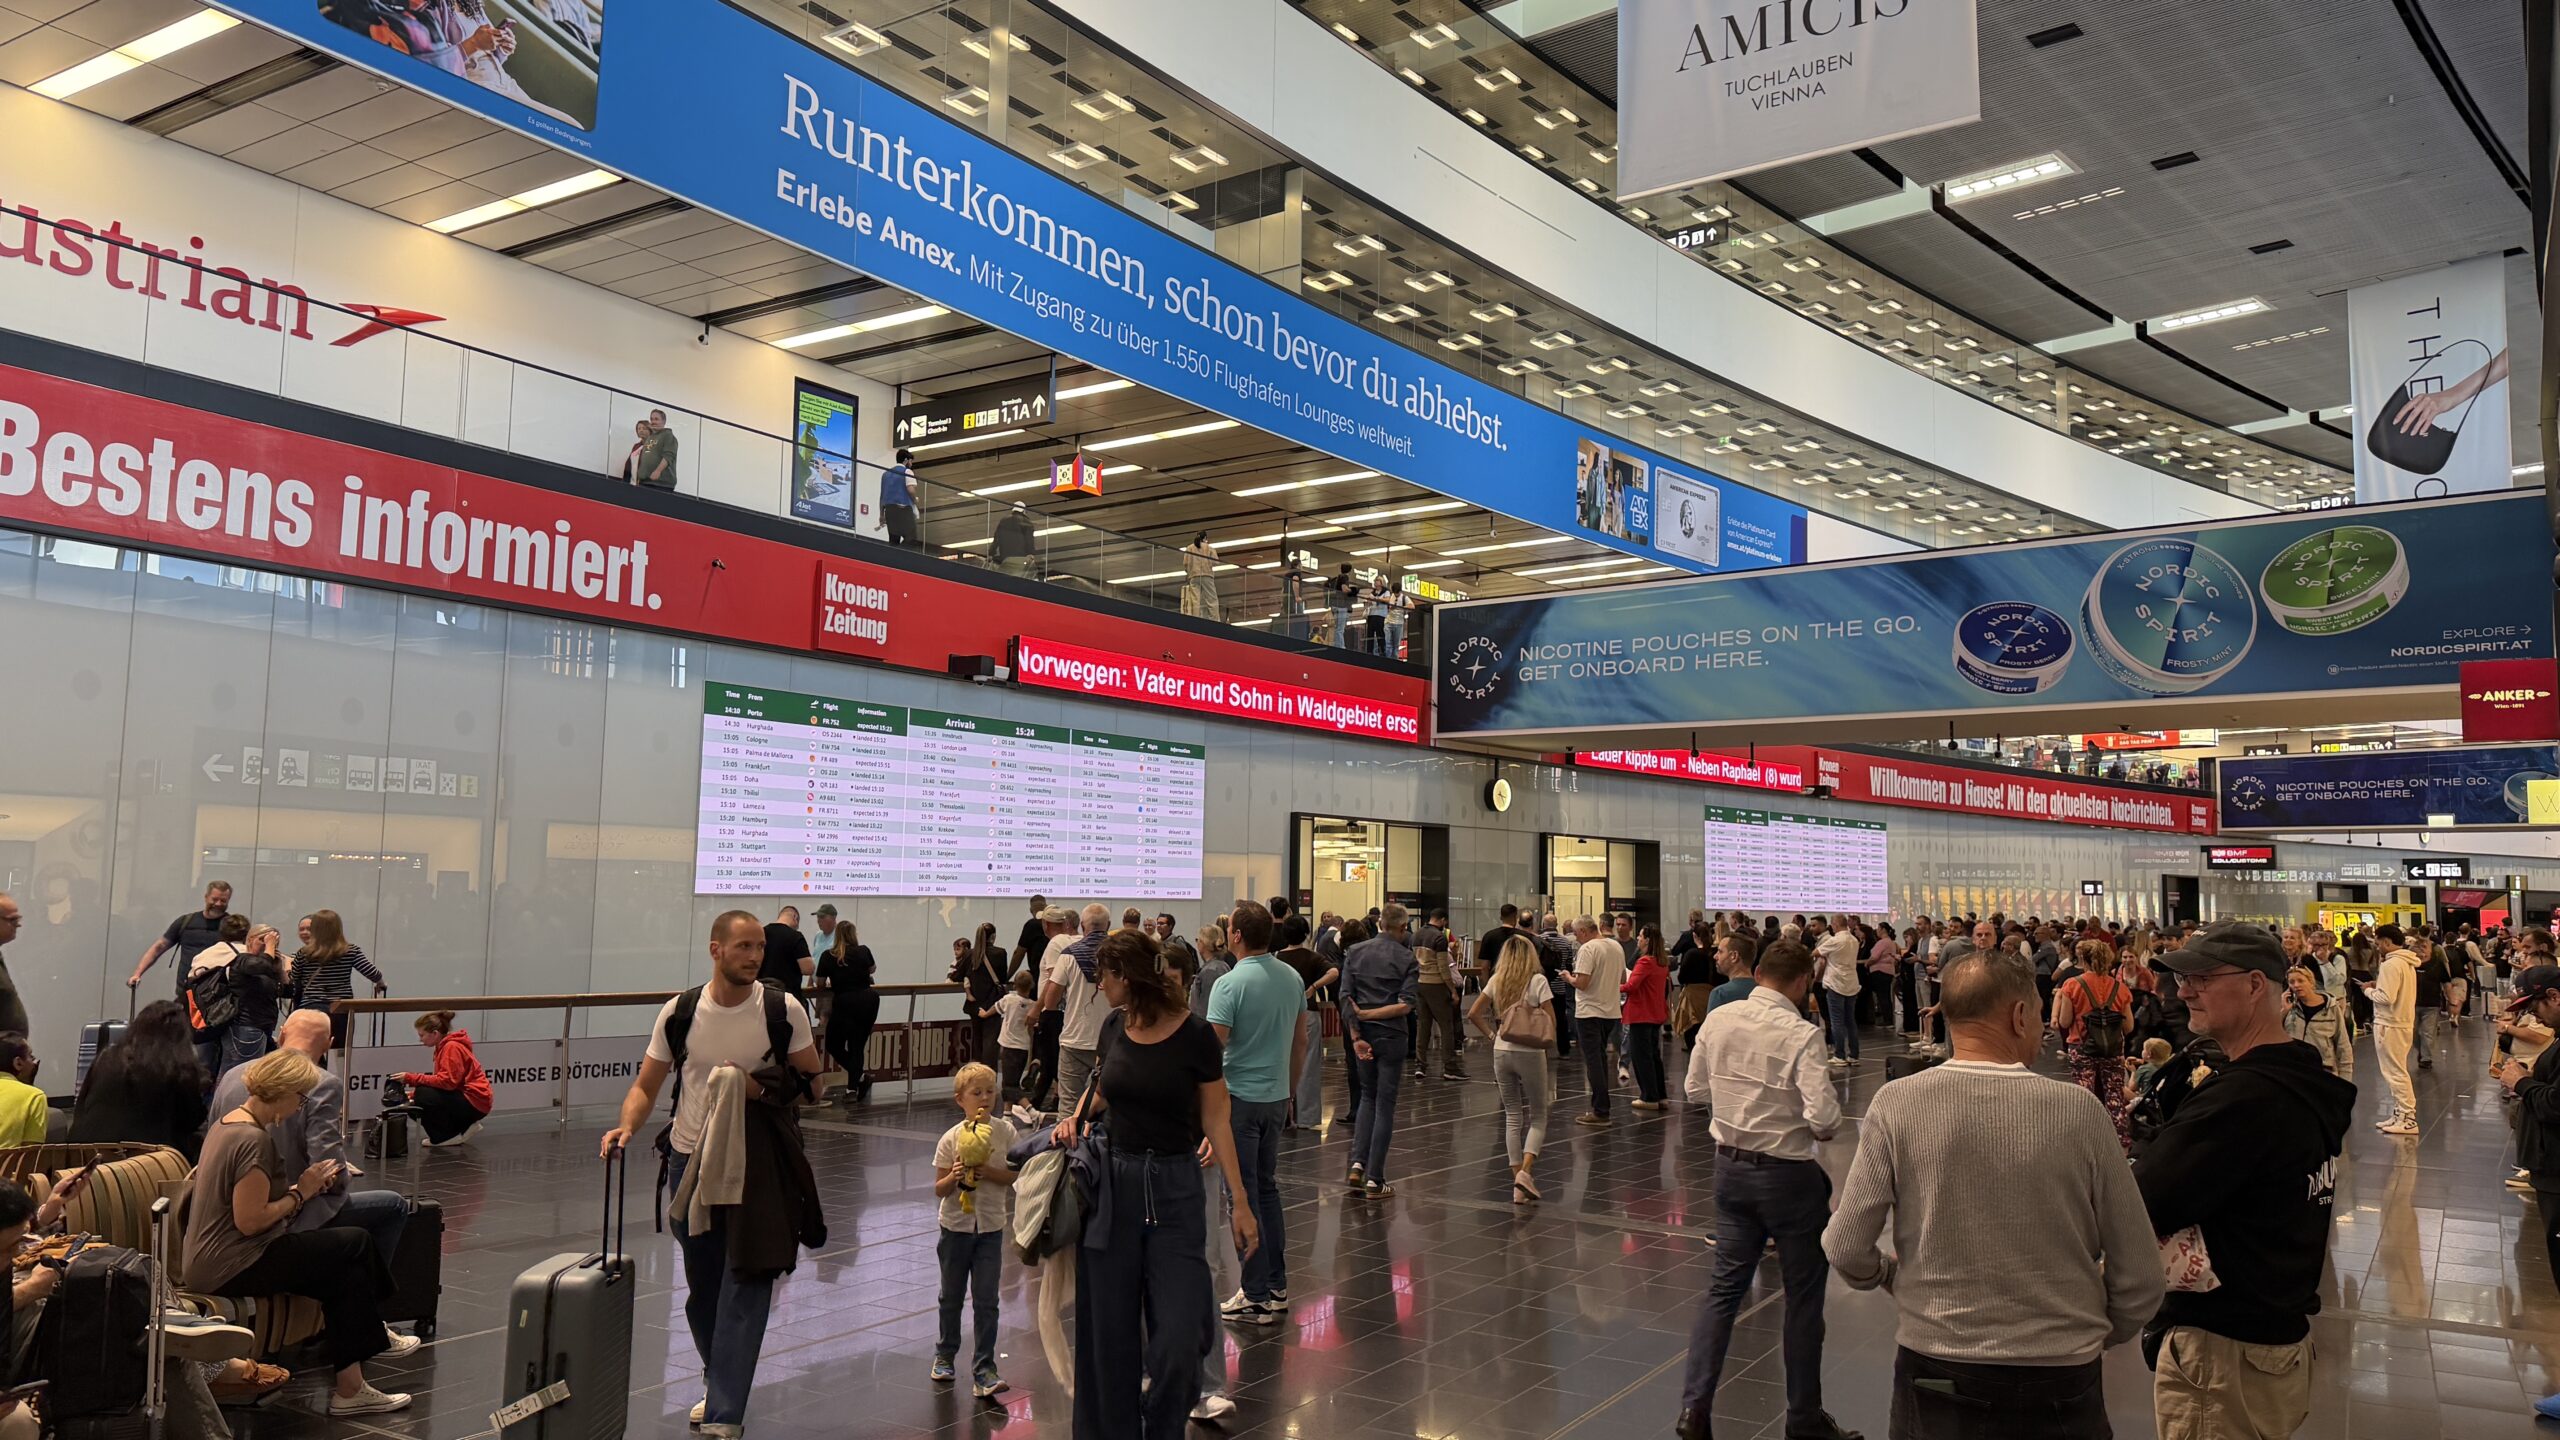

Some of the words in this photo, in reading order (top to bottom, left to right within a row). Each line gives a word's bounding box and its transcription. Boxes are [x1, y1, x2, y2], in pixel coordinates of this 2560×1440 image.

[1725, 51, 1854, 98] TUCHLAUBEN
[1752, 81, 1827, 111] VIENNA
[0, 200, 313, 342] ustrian
[780, 72, 1156, 310] Runterkommen,
[1164, 276, 1265, 352] schon
[1273, 312, 1357, 391] bevor
[1363, 357, 1398, 408] du
[1404, 377, 1508, 452] abhebst.
[777, 168, 873, 236] Erlebe
[879, 216, 961, 275] Amex.
[971, 254, 1004, 294] Mit
[1008, 272, 1085, 333] Zugang
[1090, 316, 1112, 339] zu
[1117, 322, 1159, 358] über
[1164, 339, 1210, 379] 1.550
[1214, 360, 1292, 412] Flughafen
[1295, 391, 1355, 436] Lounges
[1358, 422, 1416, 458] weltweit.
[1002, 404, 1030, 425] 1,1A
[1670, 484, 1689, 495] AMERICAN
[0, 401, 315, 548] Bestens
[340, 475, 662, 610] informiert.
[2292, 541, 2364, 572] NORDIC
[2136, 564, 2220, 599] NORDIC
[2296, 556, 2370, 588] SPIRIT
[825, 573, 889, 611] Kronen
[824, 606, 887, 645] Zeitung
[1988, 614, 2049, 634] NORDIC
[2136, 604, 2222, 643] SPIRIT
[2443, 626, 2516, 640] EXPLORE
[1451, 636, 1502, 664] NORDIC
[1520, 640, 1622, 662] NICOTINE
[1632, 629, 1751, 653] POUCHES
[1762, 625, 1798, 643] ON
[1808, 620, 1863, 639] THE
[1874, 616, 1921, 635] GO.
[1984, 632, 2046, 654] SPIRIT
[2391, 640, 2532, 657] NORDICSPIRIT.AT
[1519, 664, 1562, 682] GET
[1570, 656, 1684, 678] ONBOARD
[1696, 650, 1769, 670] HERE.
[2167, 658, 2209, 668] FROSTY
[2212, 645, 2233, 662] MINT
[1019, 646, 1127, 690] Norwegen:
[1134, 666, 1184, 697] Vater
[1190, 681, 1223, 703] und
[1229, 683, 1273, 712] Sohn
[1278, 692, 1292, 715] in
[1297, 695, 1382, 729] Waldgebiet
[1386, 714, 1417, 734] ersc
[1451, 672, 1502, 700] SPIRIT
[2483, 690, 2535, 702] ANKER
[725, 690, 740, 699] Time
[748, 693, 763, 701] From
[823, 703, 838, 712] Flight
[857, 707, 886, 718] Information
[747, 709, 763, 717] Porto
[945, 718, 975, 730] Arrivals
[1015, 727, 1034, 737] 15:24
[723, 733, 739, 741] 15:05
[746, 735, 768, 745] Cologne
[722, 760, 738, 768] 15:05
[745, 762, 770, 770] Frankfurt
[745, 749, 763, 757] Palma
[771, 751, 793, 759] Mallorca
[1625, 751, 1658, 770] kippte
[1660, 758, 1676, 771] um
[1688, 758, 1720, 776] Neben
[1722, 762, 1760, 782] Raphael
[1765, 768, 1777, 788] (8)
[1819, 757, 1840, 774] Kronen
[744, 775, 759, 783] Doha
[1819, 773, 1840, 789] Zeitung
[2232, 776, 2265, 791] NORDIC
[2276, 782, 2335, 791] NICOTINE
[2340, 780, 2404, 790] POUCHES
[2409, 779, 2429, 787] ON
[2434, 778, 2462, 786] THE
[2466, 777, 2490, 786] GO.
[720, 787, 737, 795] 15:10
[1870, 765, 1947, 804] Willkommen
[1949, 783, 1962, 805] zu
[1966, 777, 2004, 811] Hause!
[2008, 784, 2024, 813] Mit
[2027, 790, 2048, 815] den
[2050, 790, 2108, 821] aktuellsten
[2111, 796, 2175, 827] Nachrichten.
[2276, 793, 2302, 801] GET
[2305, 791, 2369, 800] ONBOARD
[2375, 790, 2414, 798] HERE.
[2232, 796, 2266, 811] SPIRIT
[719, 814, 735, 822] 15:20
[742, 815, 767, 825] Hamburg
[741, 842, 766, 851] Stuttgart
[738, 883, 761, 891] Cologne
[350, 1074, 382, 1091] GET
[487, 1066, 547, 1084] ENNESE
[551, 1060, 631, 1081] BRÖTCHEN
